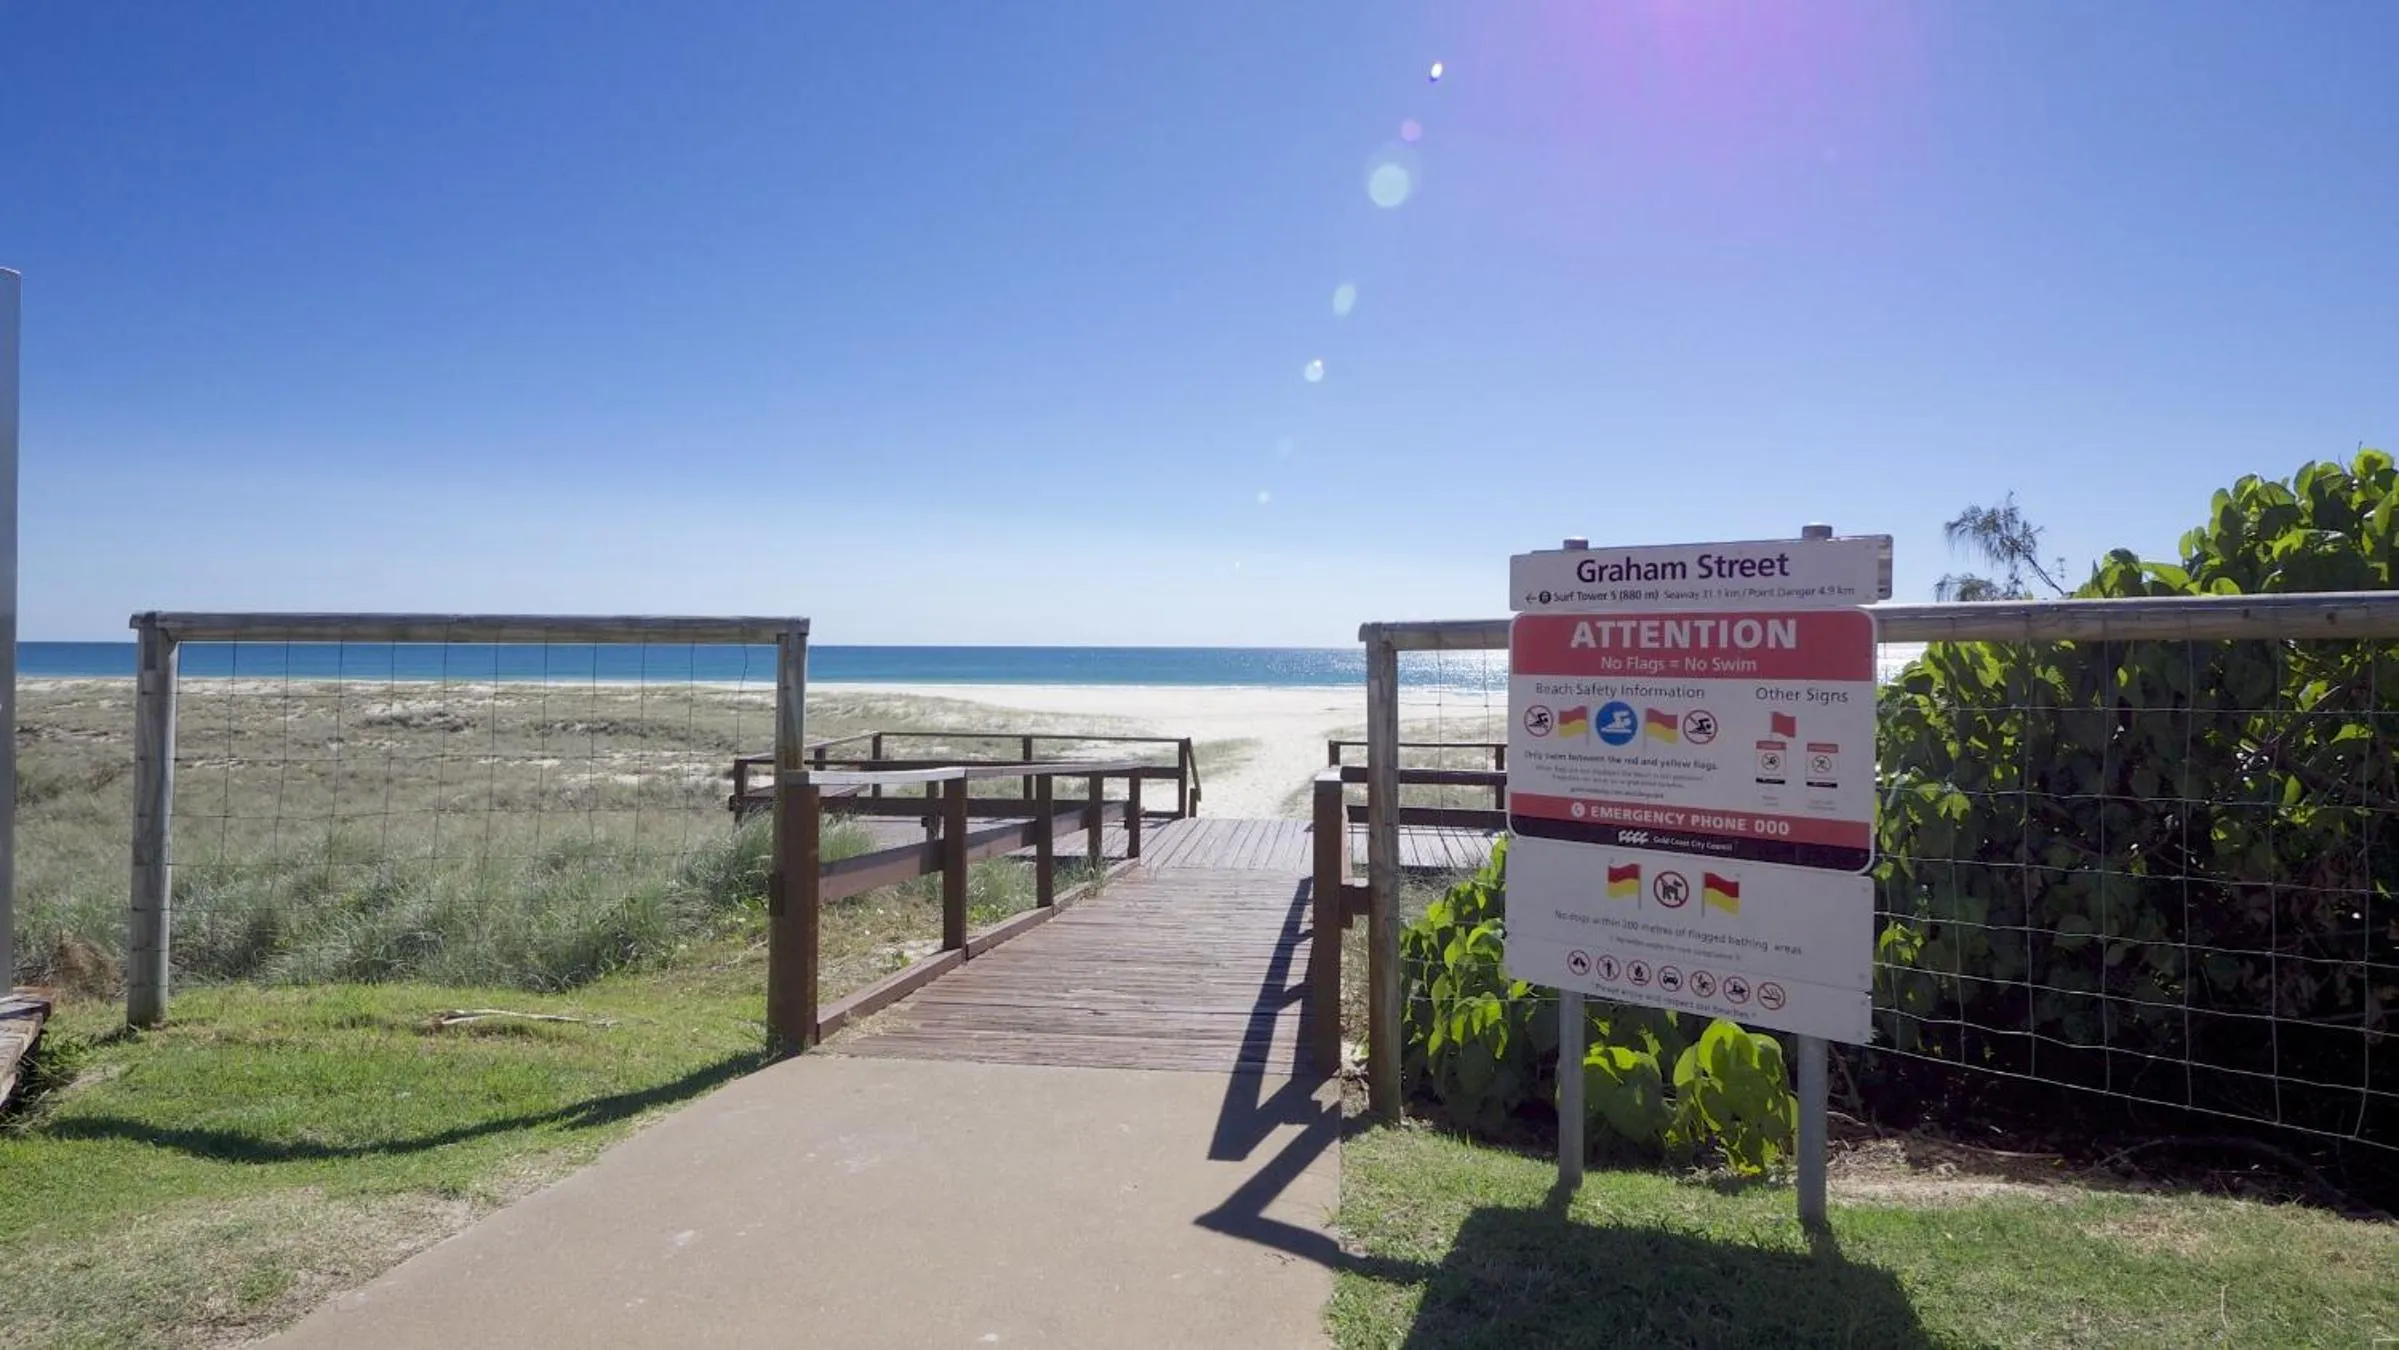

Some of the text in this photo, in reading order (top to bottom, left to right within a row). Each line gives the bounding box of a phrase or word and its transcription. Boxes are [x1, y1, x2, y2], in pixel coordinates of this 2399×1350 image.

[1576, 551, 1791, 584] Graham Street
[1553, 591, 1574, 602] Surf
[1577, 591, 1607, 601] Tower
[1619, 590, 1642, 602] (880
[1644, 590, 1659, 601] m)
[1778, 587, 1815, 599] Danger
[1837, 585, 1855, 596] km
[1570, 618, 1797, 650] ATTENTION
[1601, 656, 1622, 670] No
[1627, 656, 1665, 673] Flags
[1685, 657, 1707, 672] No
[1712, 656, 1757, 672] Swim
[1536, 682, 1705, 699] Beach Safety Information
[1756, 686, 1849, 704] Other Signs
[1641, 756, 1657, 767] and
[1661, 757, 1691, 769] yellow
[1590, 806, 1790, 836] EMERGENCY PHONE 000
[1653, 835, 1733, 851] Gold Coast City Council
[1675, 927, 1687, 937] of
[1688, 929, 1726, 945] flagged
[1728, 935, 1768, 953] bathing
